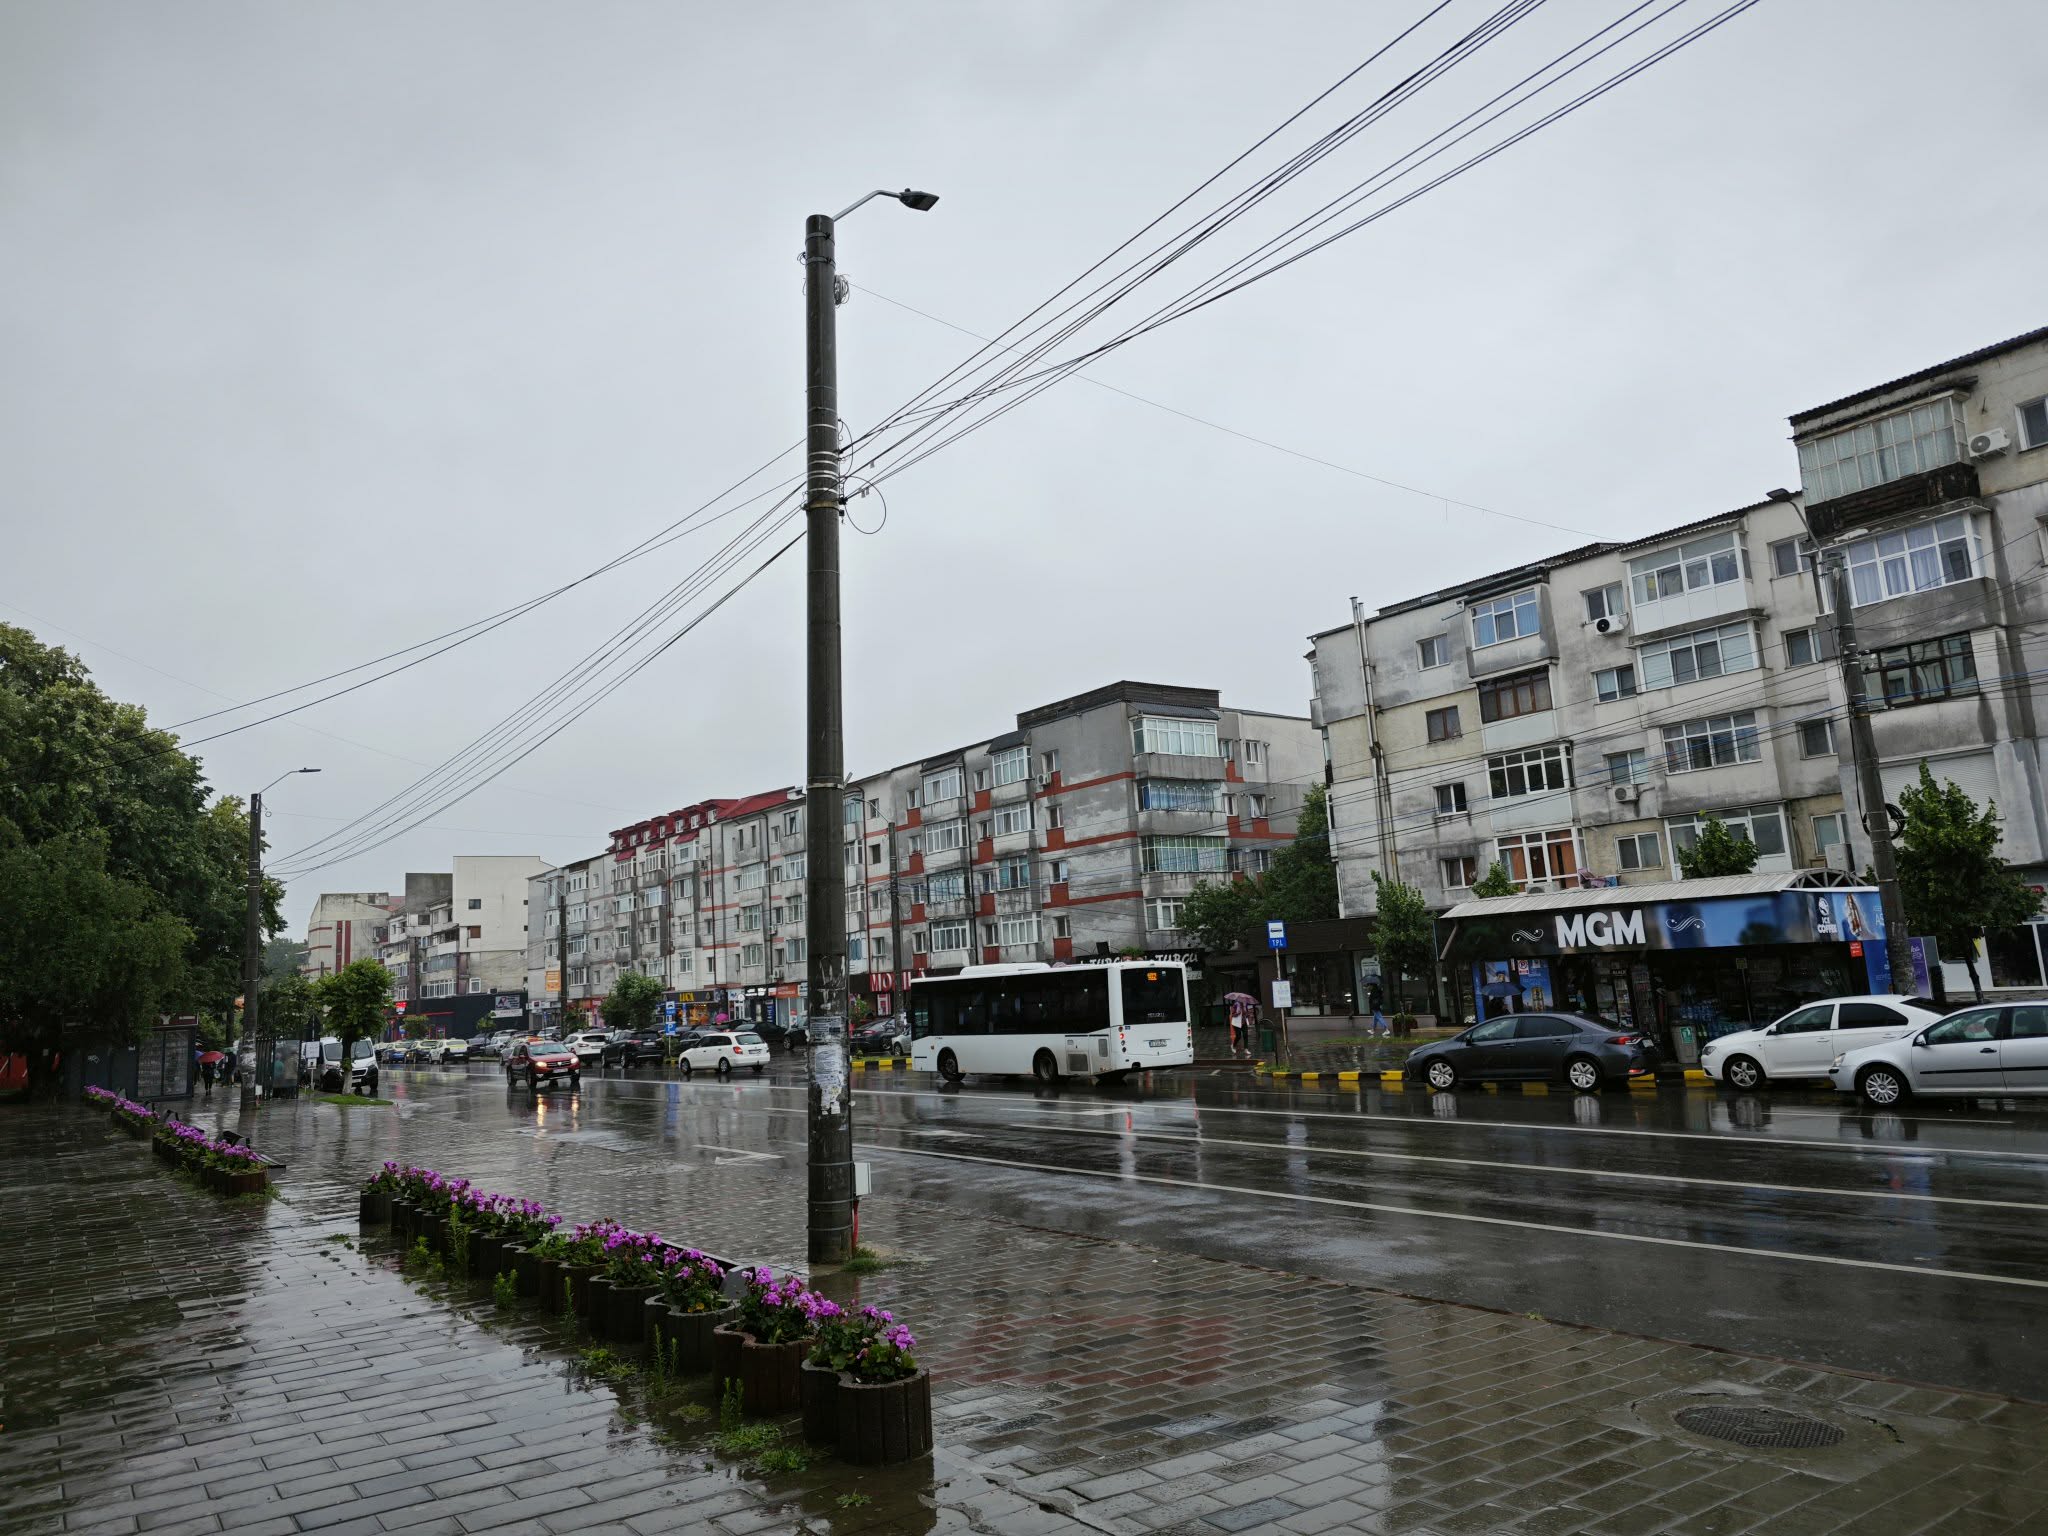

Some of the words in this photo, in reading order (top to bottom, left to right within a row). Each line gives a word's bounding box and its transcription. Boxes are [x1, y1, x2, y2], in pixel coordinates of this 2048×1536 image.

[1554, 909, 1647, 948] MGM
[1817, 924, 1838, 934] COFFEE
[1272, 939, 1284, 947] TPL
